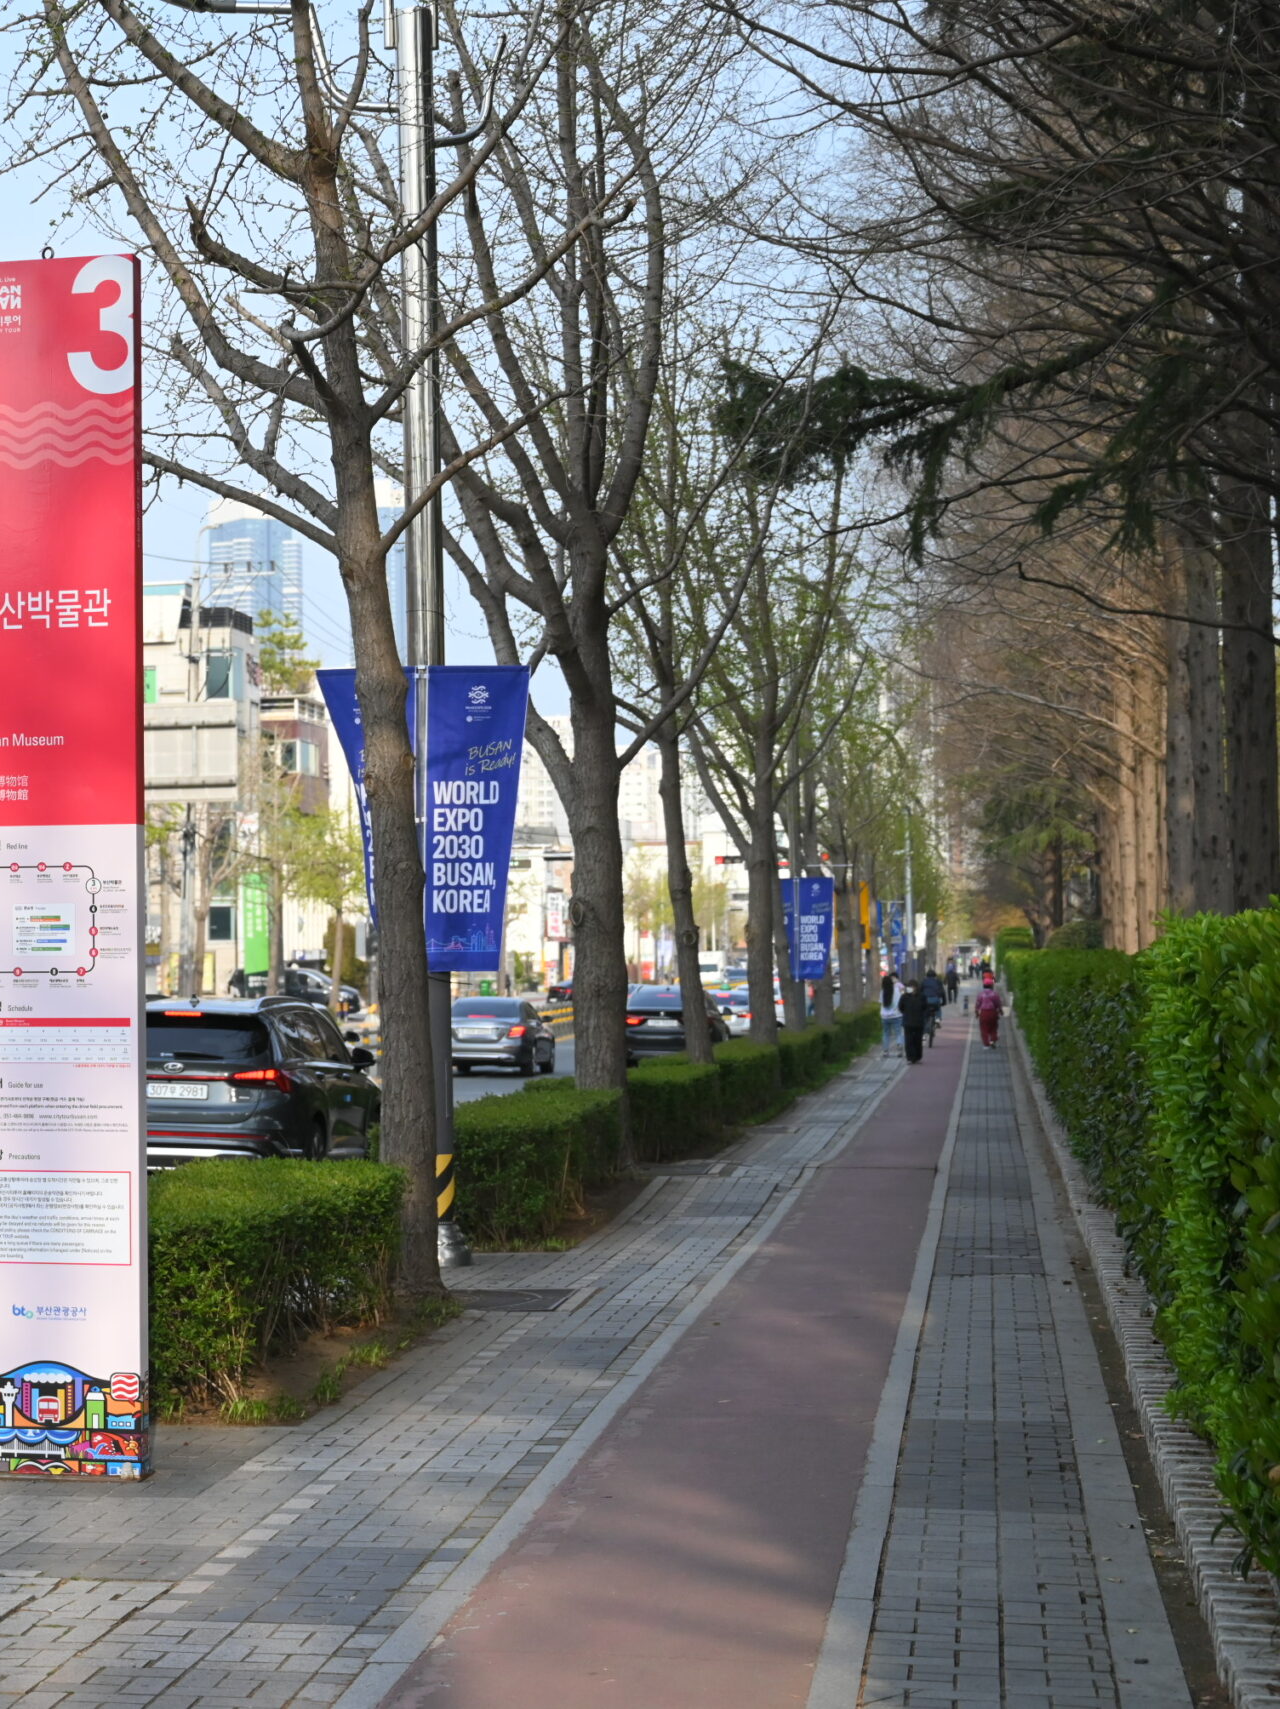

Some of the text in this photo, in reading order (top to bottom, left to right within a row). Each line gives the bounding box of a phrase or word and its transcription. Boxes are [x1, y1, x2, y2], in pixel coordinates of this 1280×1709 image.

[67, 255, 134, 394] 3
[12, 733, 64, 747] Museum
[468, 738, 512, 760] BUSAN
[465, 752, 516, 776] is Ready!
[433, 781, 499, 805] WORLD
[433, 808, 484, 832] EXPO
[432, 835, 484, 859] 2030
[433, 862, 496, 890] BUSAN,
[432, 890, 491, 914] KOREA
[800, 915, 825, 924] WORLD
[800, 925, 817, 933] EXPO
[800, 952, 823, 960] KOREA
[8, 1152, 40, 1160] Precautions
[36, 1306, 86, 1317] 부산관광공사
